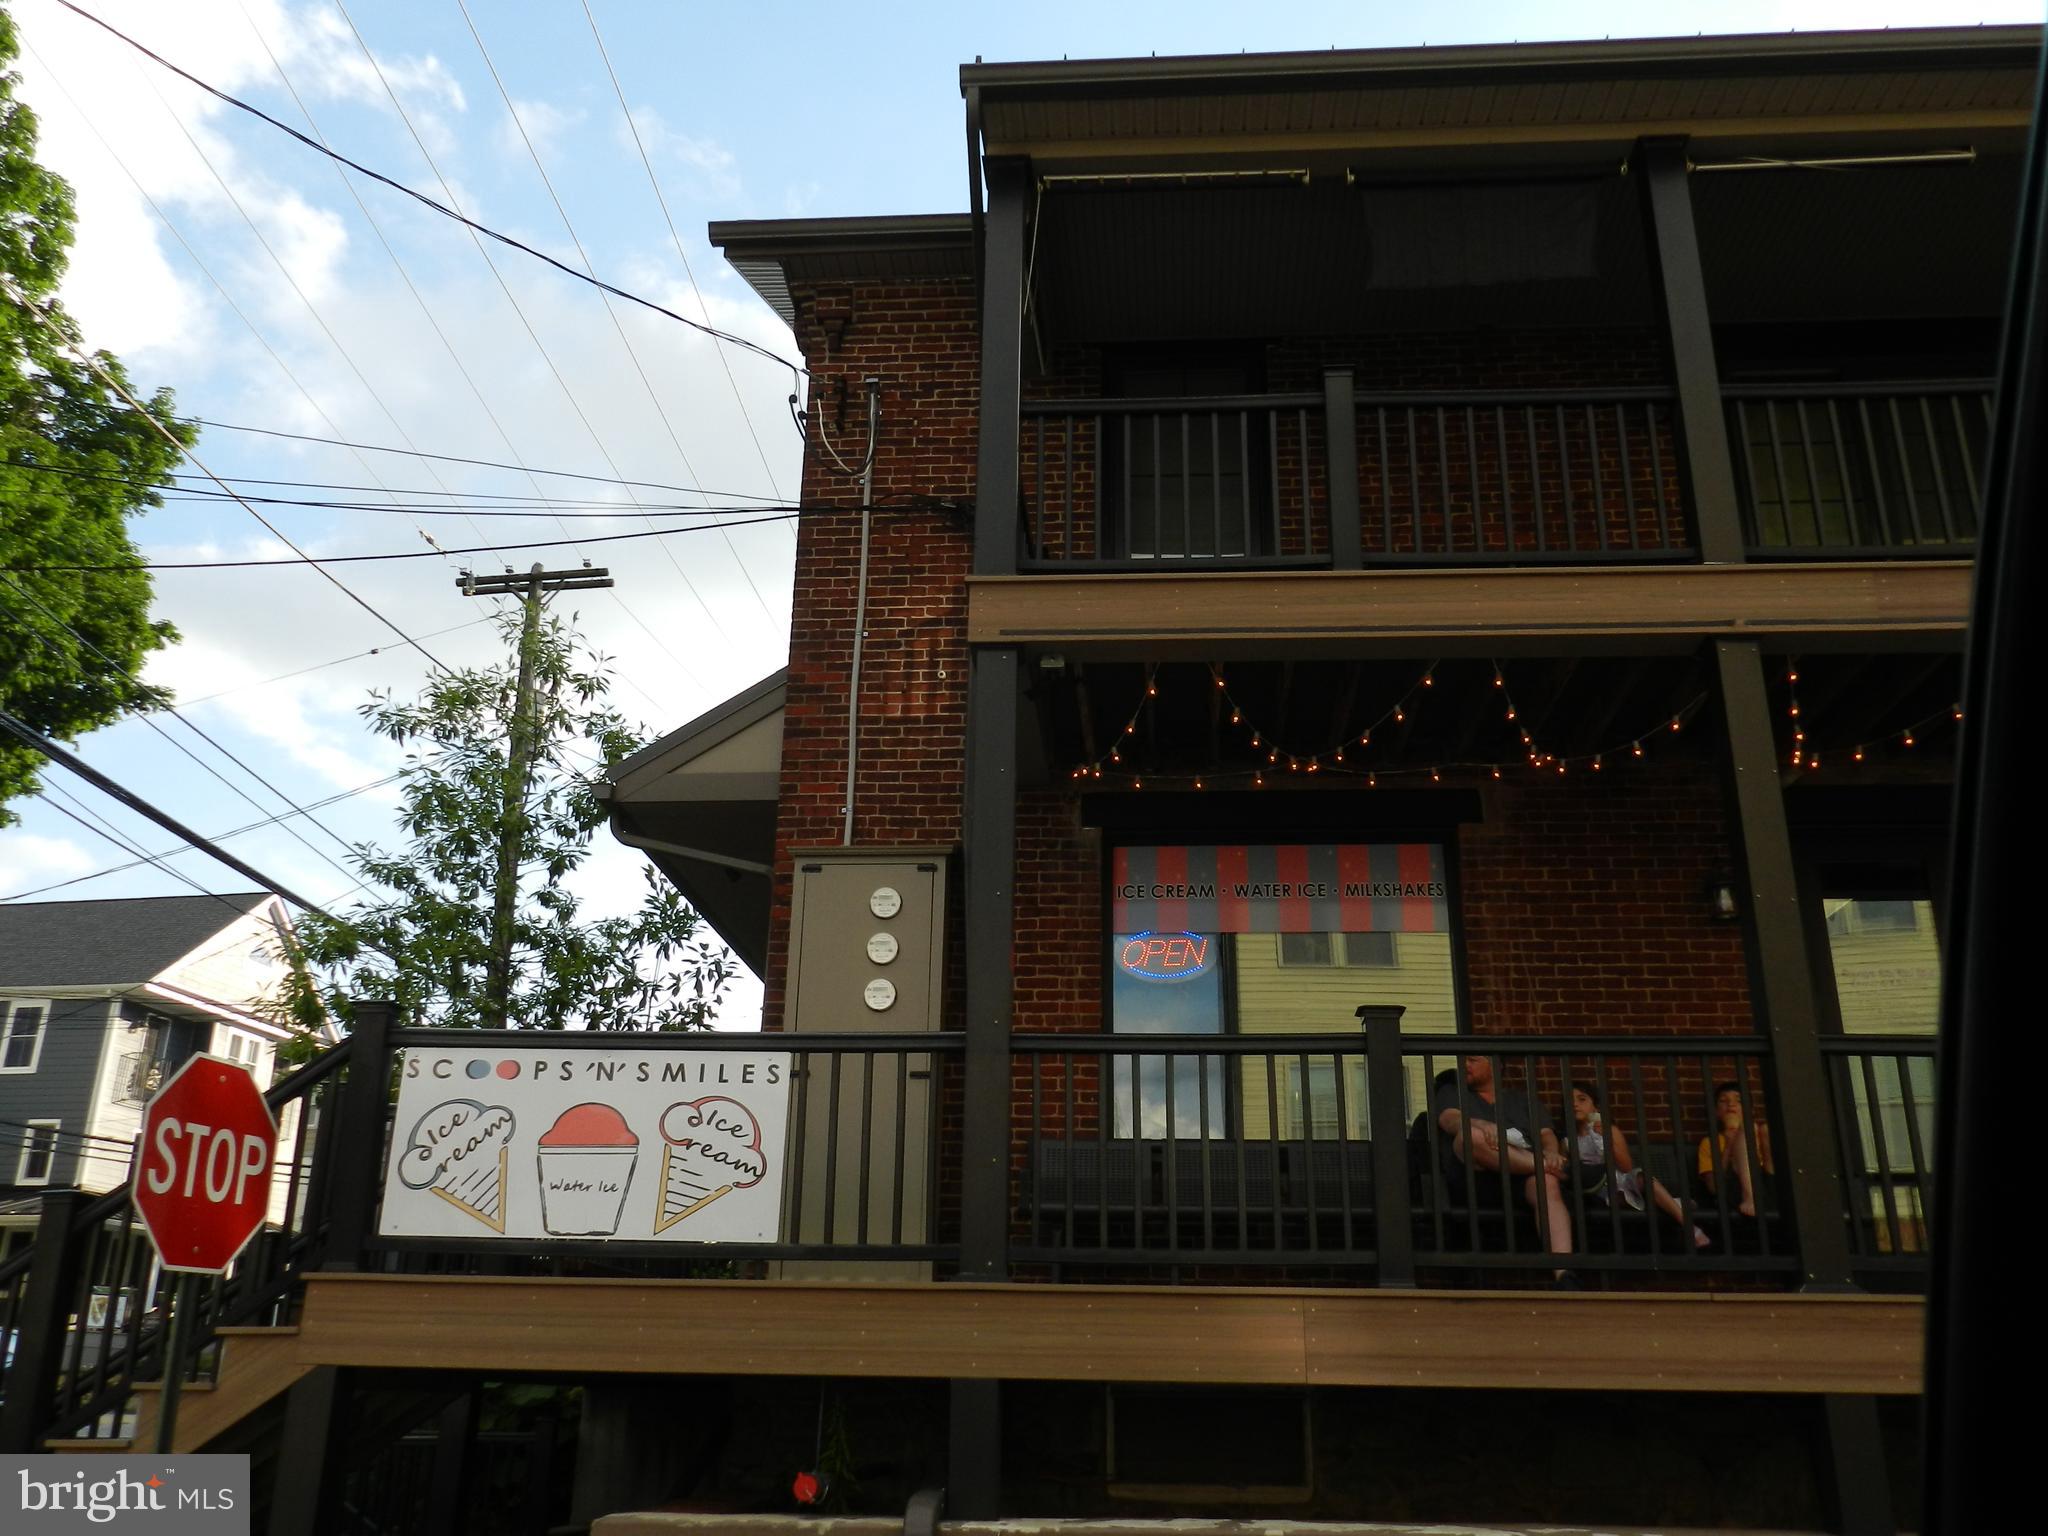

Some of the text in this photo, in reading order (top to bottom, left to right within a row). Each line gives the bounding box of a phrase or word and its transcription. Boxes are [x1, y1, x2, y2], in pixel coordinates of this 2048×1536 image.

[1116, 882, 1445, 899] ICE CREAM WATER ICE MILKSHAKES
[1121, 938, 1209, 968] OPEN
[427, 1110, 470, 1145] Ice
[706, 1109, 750, 1138] Ice
[147, 1117, 268, 1206] STOP
[598, 1181, 620, 1193] Ice
